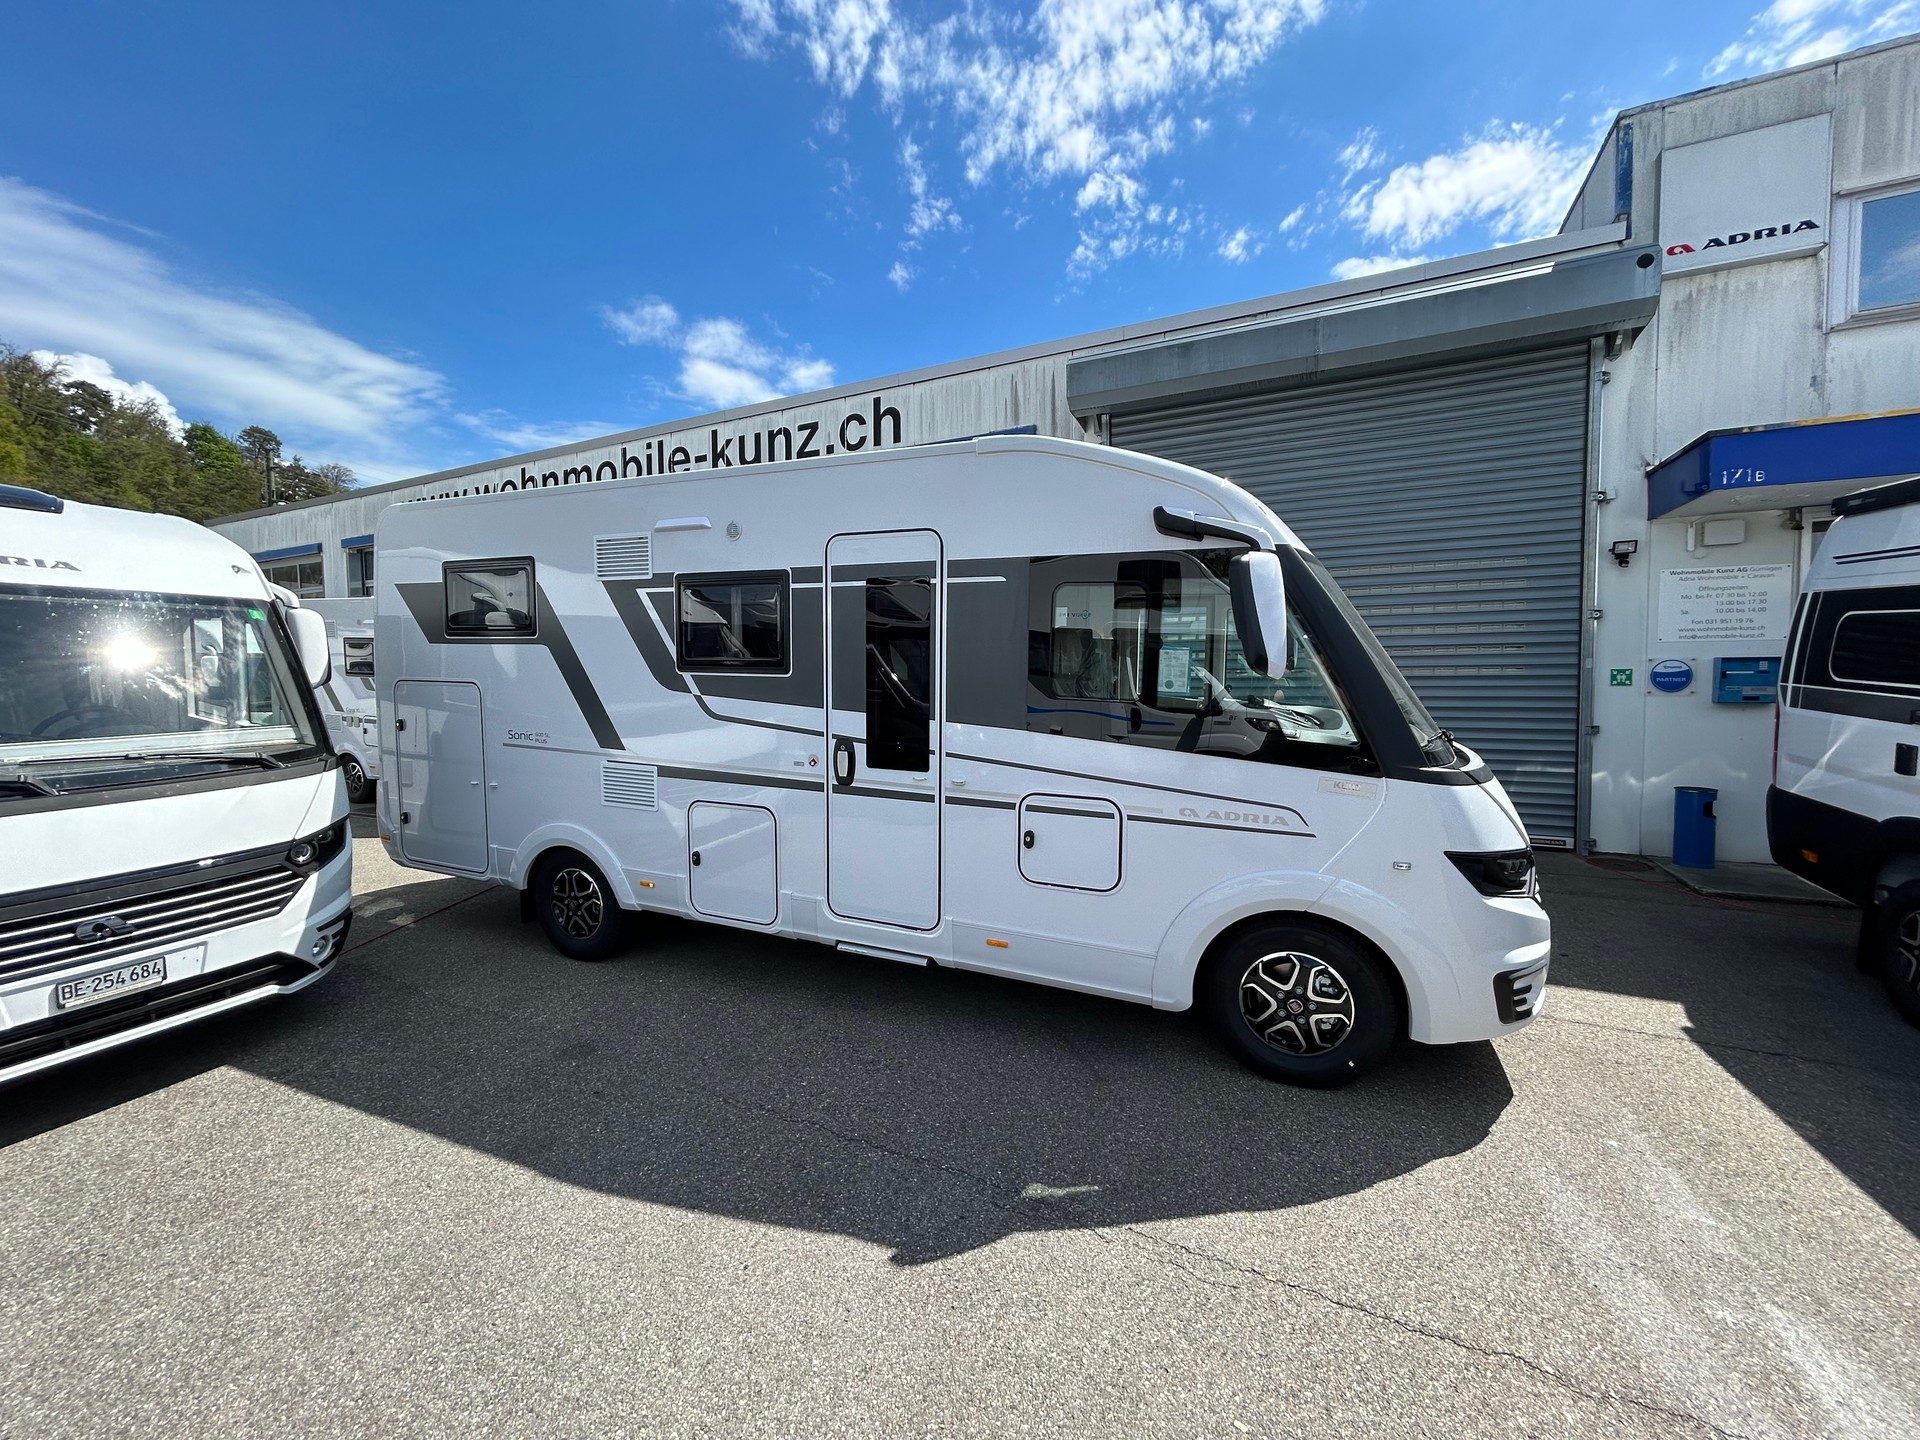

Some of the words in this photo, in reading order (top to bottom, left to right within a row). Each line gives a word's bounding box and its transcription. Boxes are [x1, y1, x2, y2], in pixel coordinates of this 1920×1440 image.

[1702, 219, 1821, 251] ADRIA
[402, 396, 902, 503] wohnmobile-kunz.ch
[1669, 568, 1715, 576] Wohnmobile
[1678, 625, 1766, 633] www.wohnmobile-kunz.ch
[507, 730, 534, 741] Sonic
[1205, 809, 1290, 826] ADRIA
